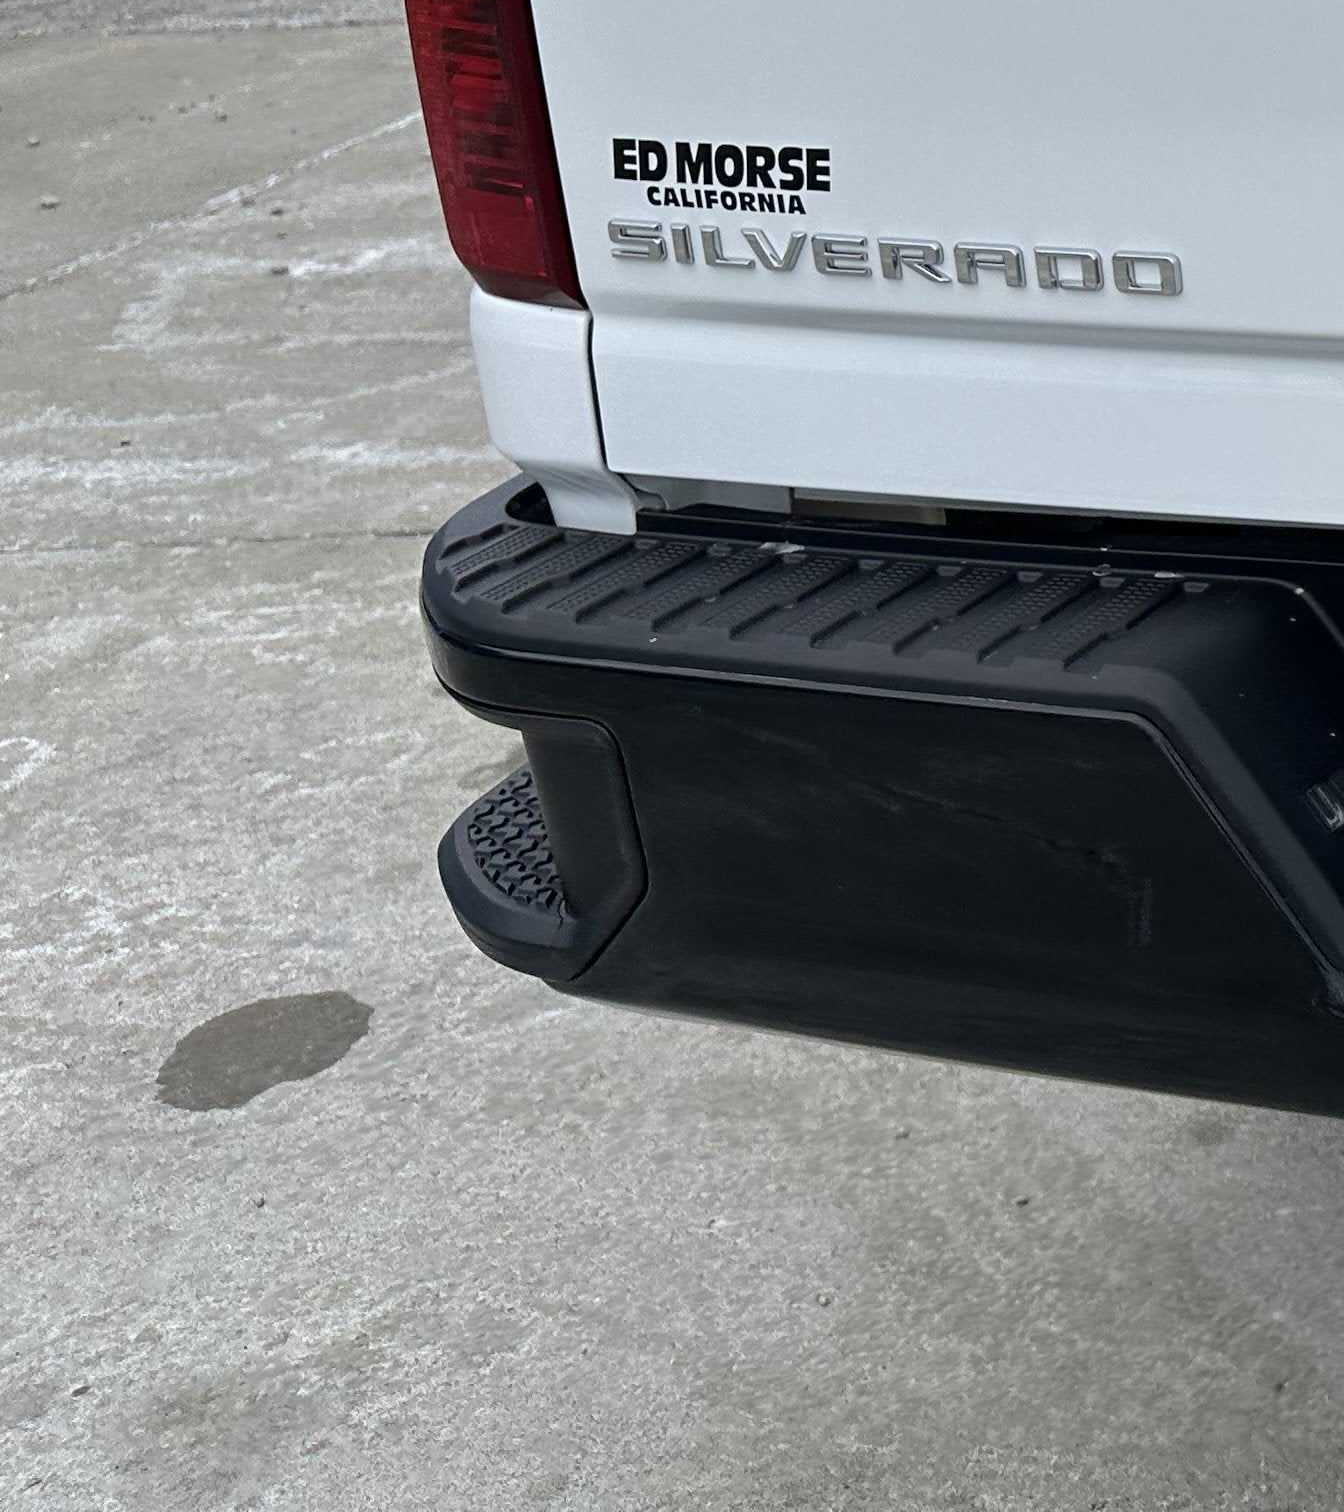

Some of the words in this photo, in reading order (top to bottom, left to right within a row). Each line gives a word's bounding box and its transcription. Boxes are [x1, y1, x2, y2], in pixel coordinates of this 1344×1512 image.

[612, 138, 667, 180] ED
[675, 141, 831, 192] MORSE
[646, 186, 807, 215] CALIFORNIA
[607, 217, 1184, 297] SILVERADO
